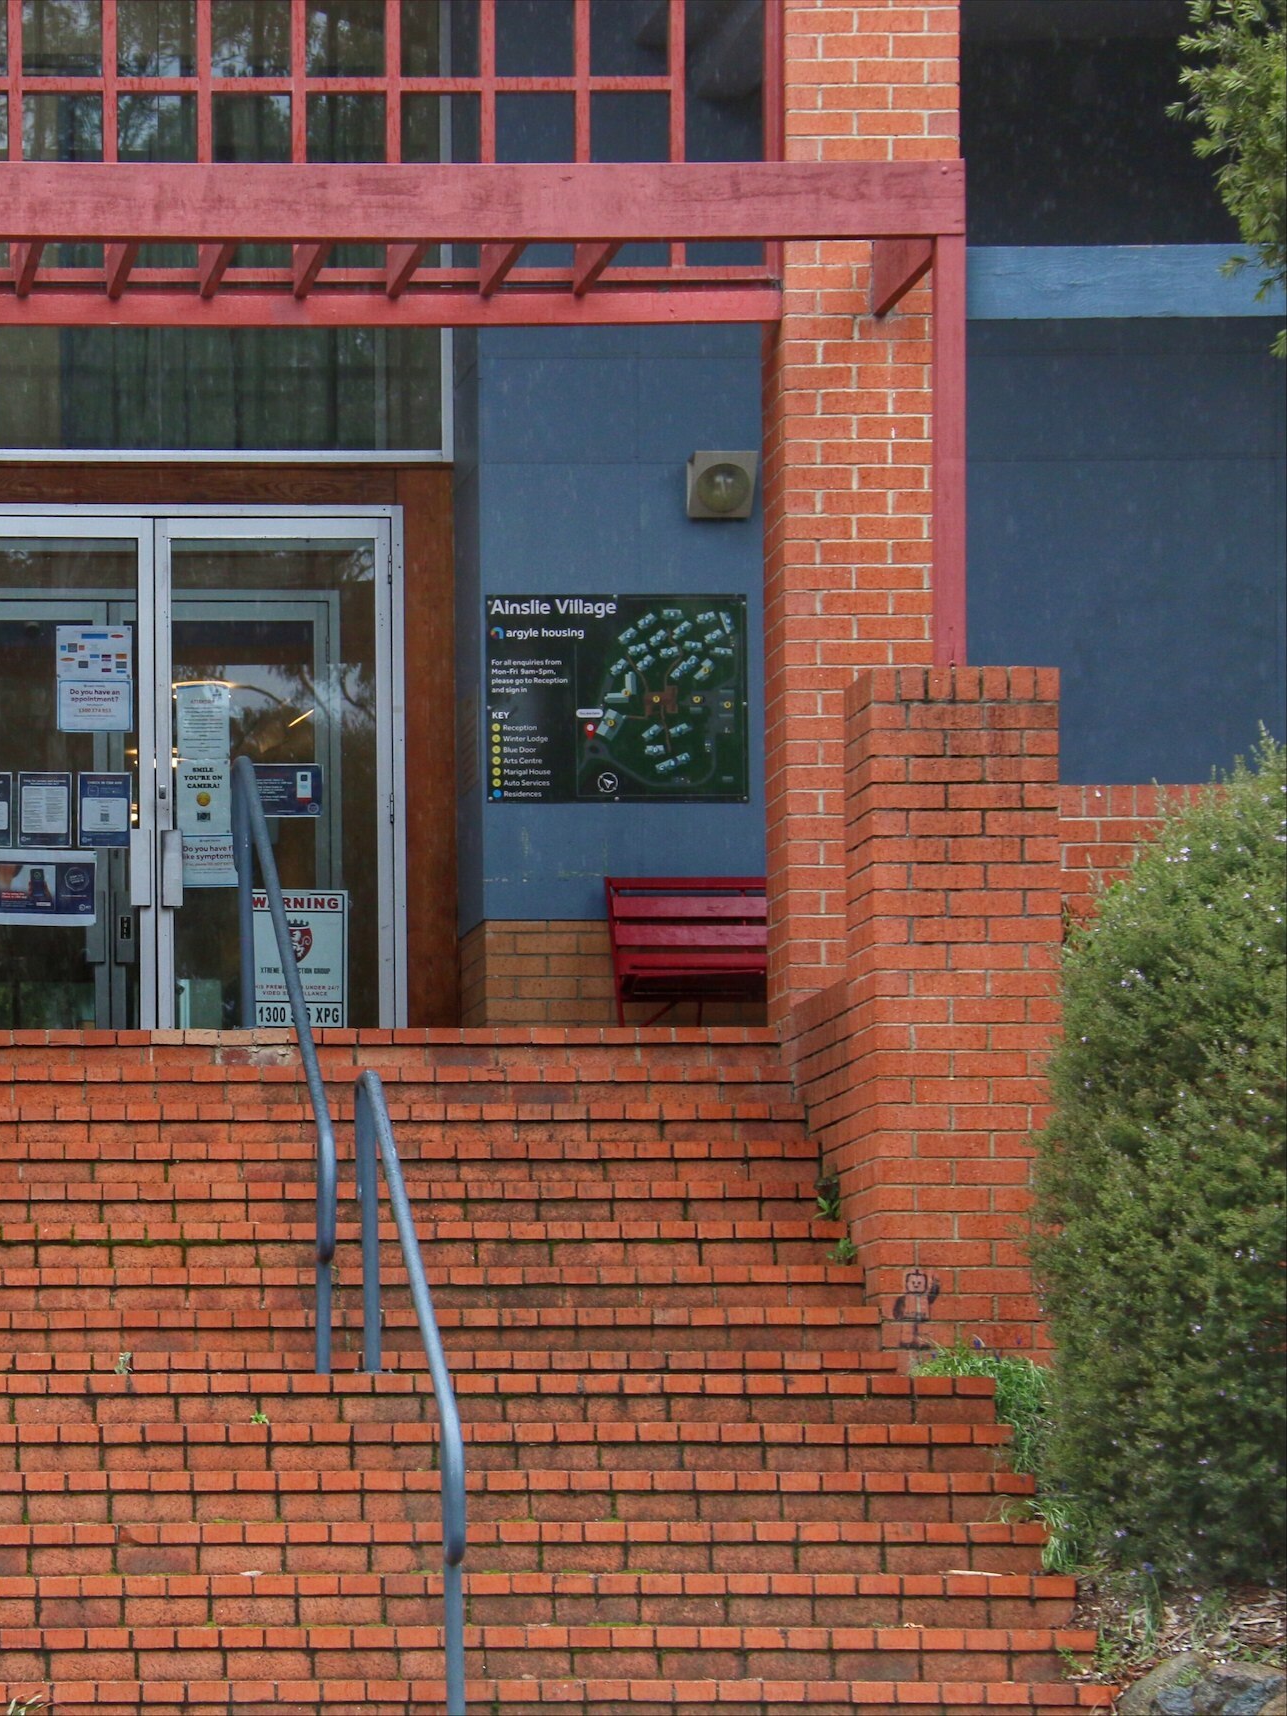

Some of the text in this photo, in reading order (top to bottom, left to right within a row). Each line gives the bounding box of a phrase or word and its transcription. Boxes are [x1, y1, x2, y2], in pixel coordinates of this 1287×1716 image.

[491, 599, 616, 618] Ainslie Village
[506, 628, 584, 639] argyle housing
[492, 711, 510, 719] KEY
[252, 897, 339, 909] WRNING
[258, 1006, 286, 1022] 1300
[315, 1007, 339, 1023] XPG
